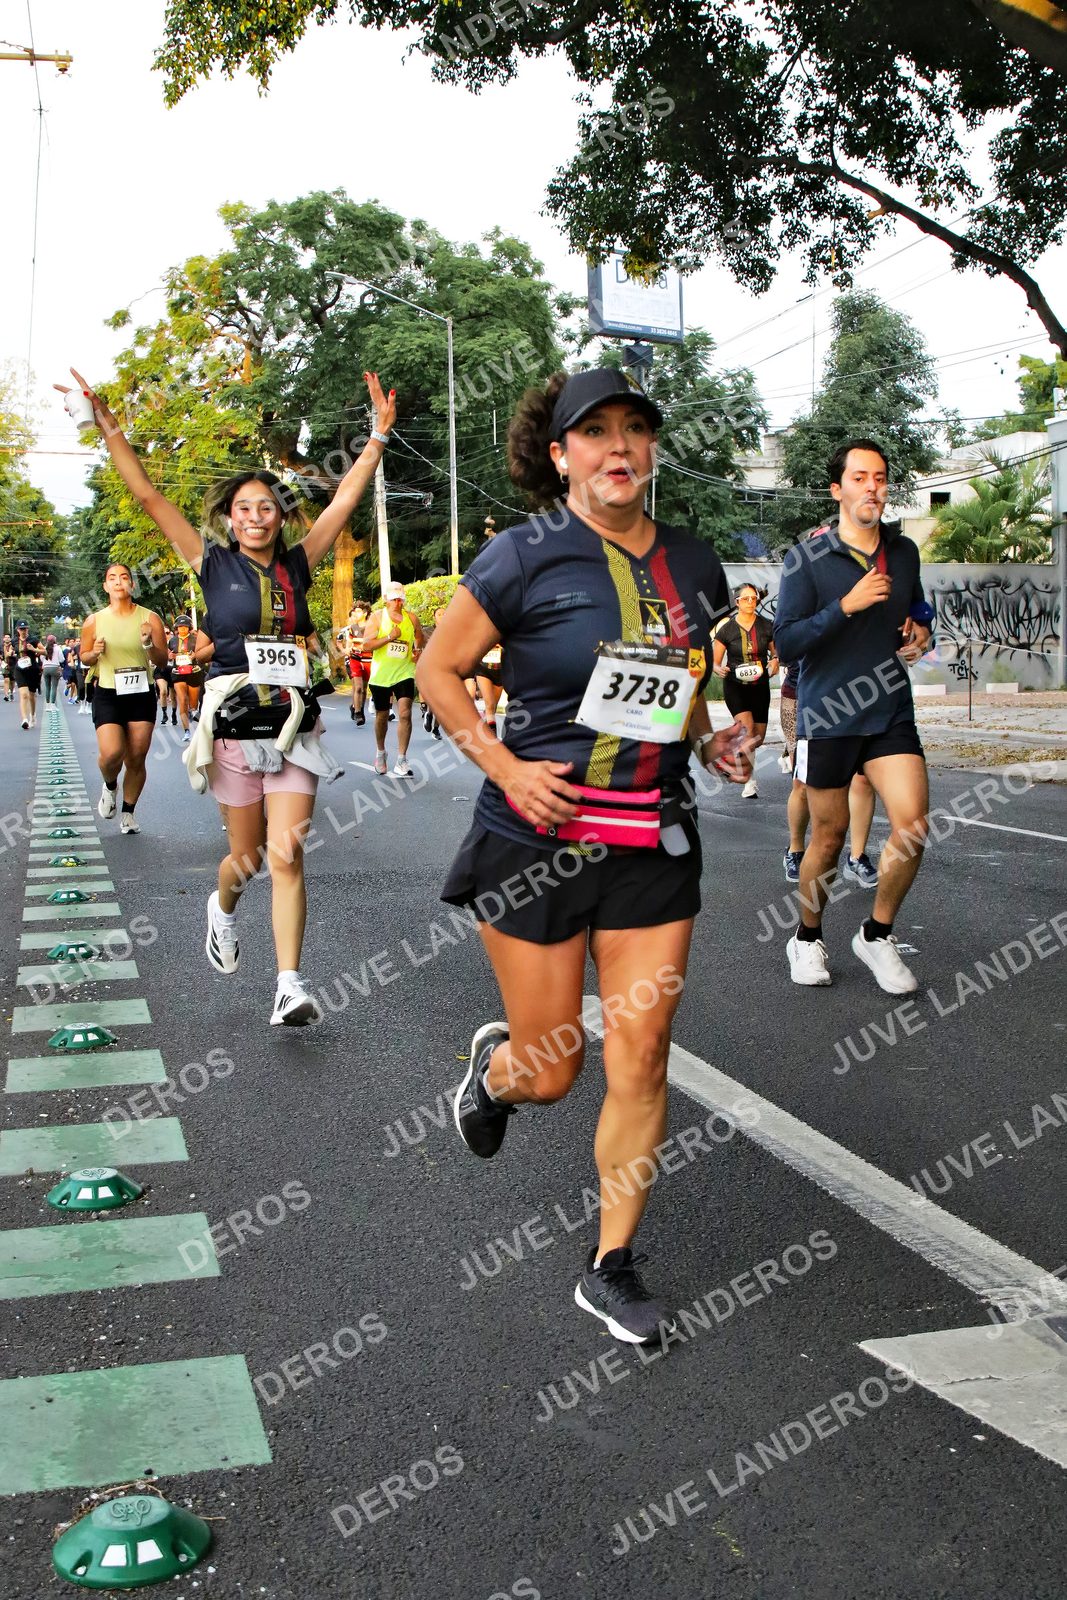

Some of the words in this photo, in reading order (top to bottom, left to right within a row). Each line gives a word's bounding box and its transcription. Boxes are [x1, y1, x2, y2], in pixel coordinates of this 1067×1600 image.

[390, 644, 406, 653] 3753
[256, 648, 296, 666] 3965
[739, 668, 758, 677] 6835
[124, 675, 139, 684] 777
[602, 672, 679, 709] 3738
